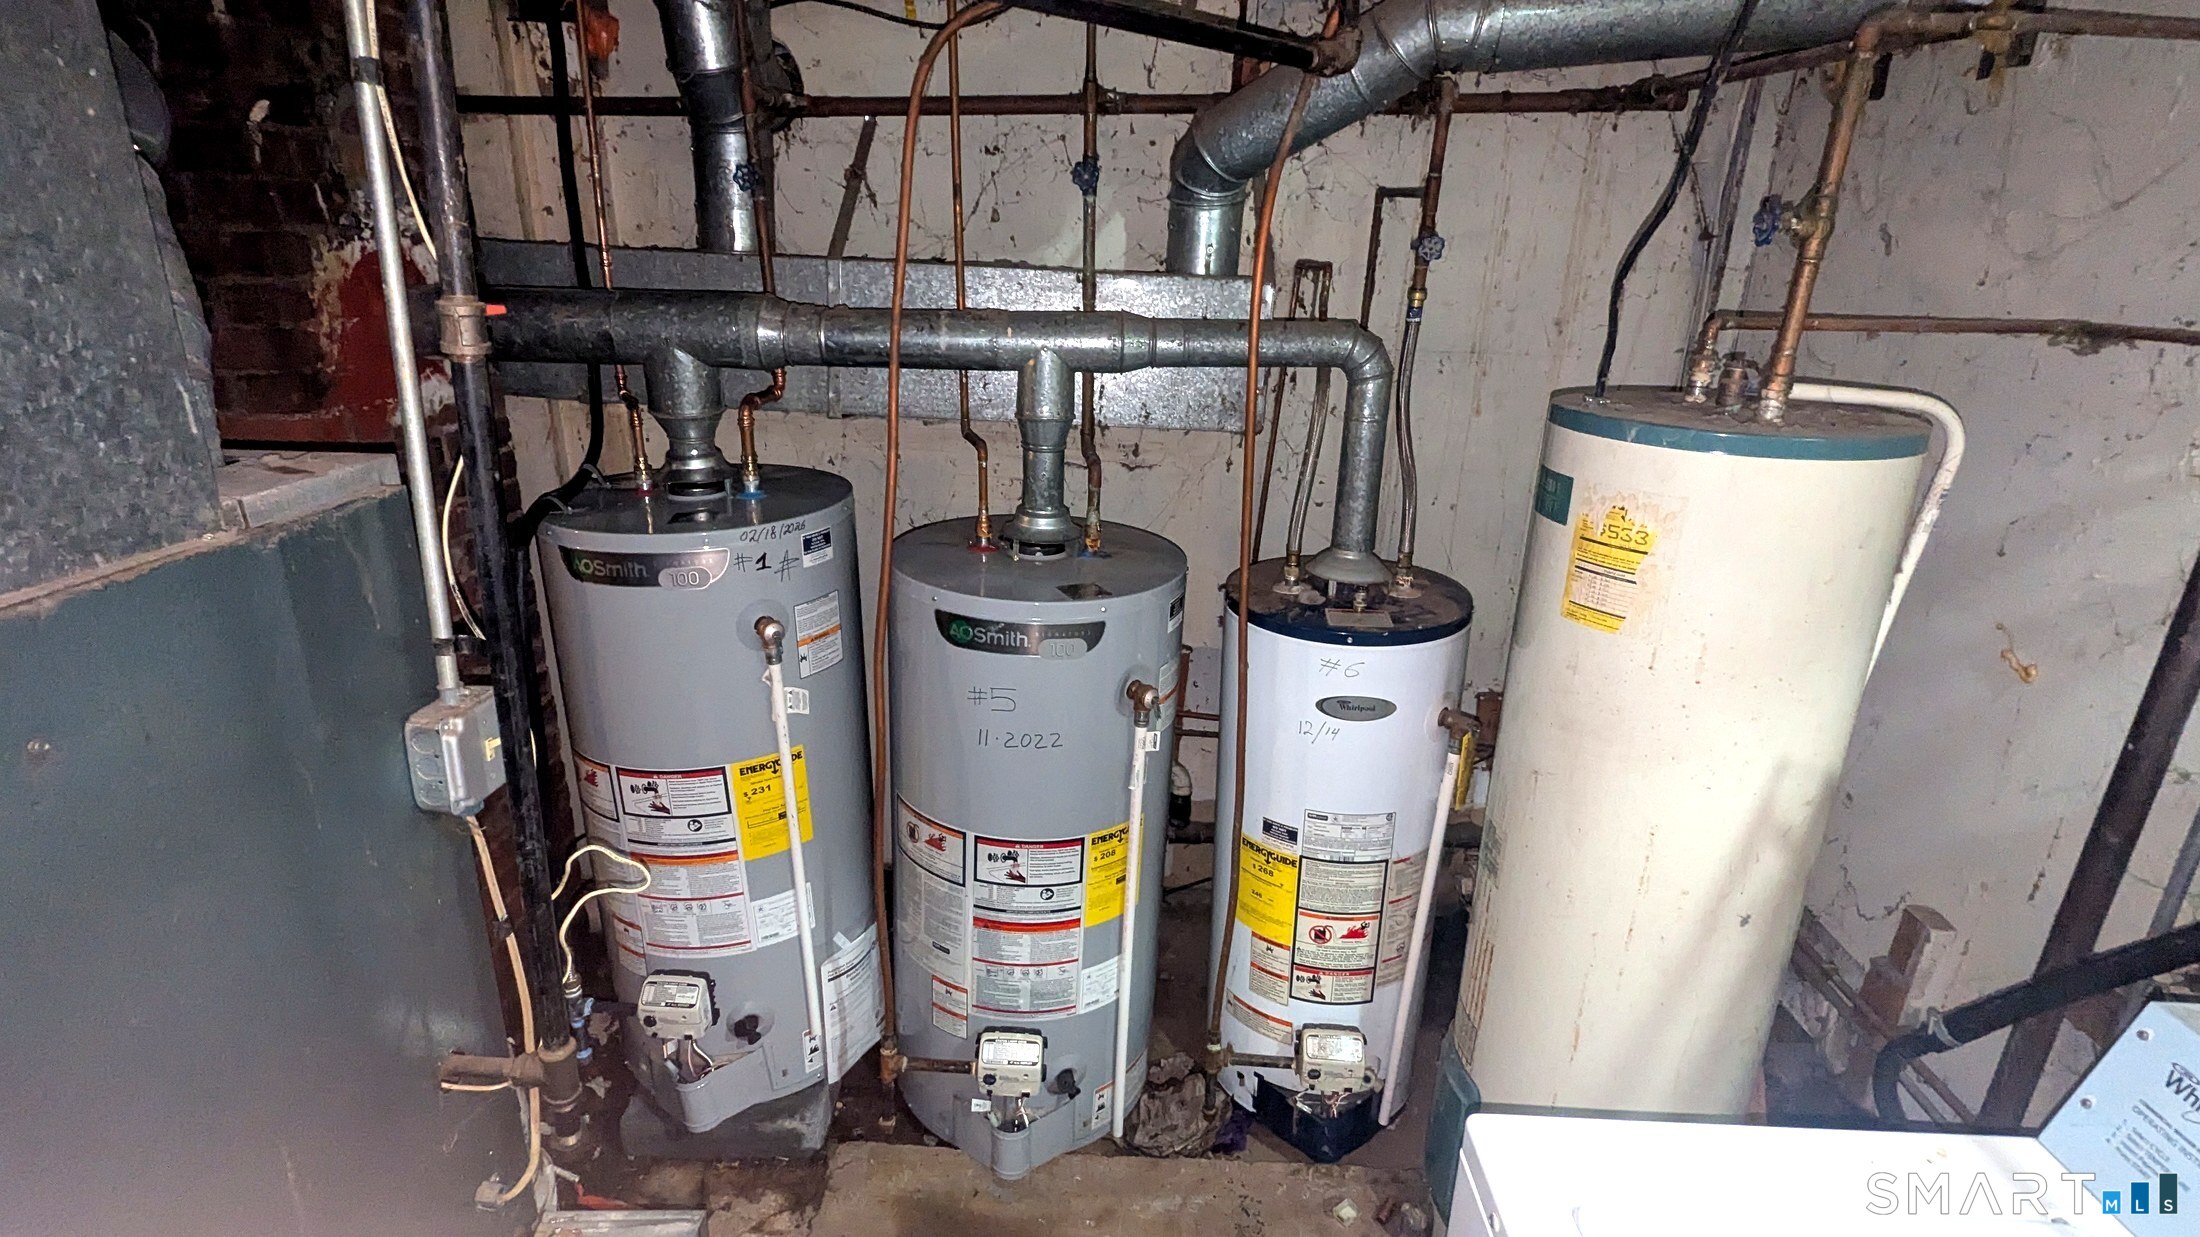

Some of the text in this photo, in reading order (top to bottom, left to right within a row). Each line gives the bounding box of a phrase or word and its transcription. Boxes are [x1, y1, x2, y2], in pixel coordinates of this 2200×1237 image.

[669, 570, 700, 587] 100
[1318, 657, 1366, 679] #6
[967, 686, 1017, 712] #5
[1298, 720, 1341, 745] 12/14
